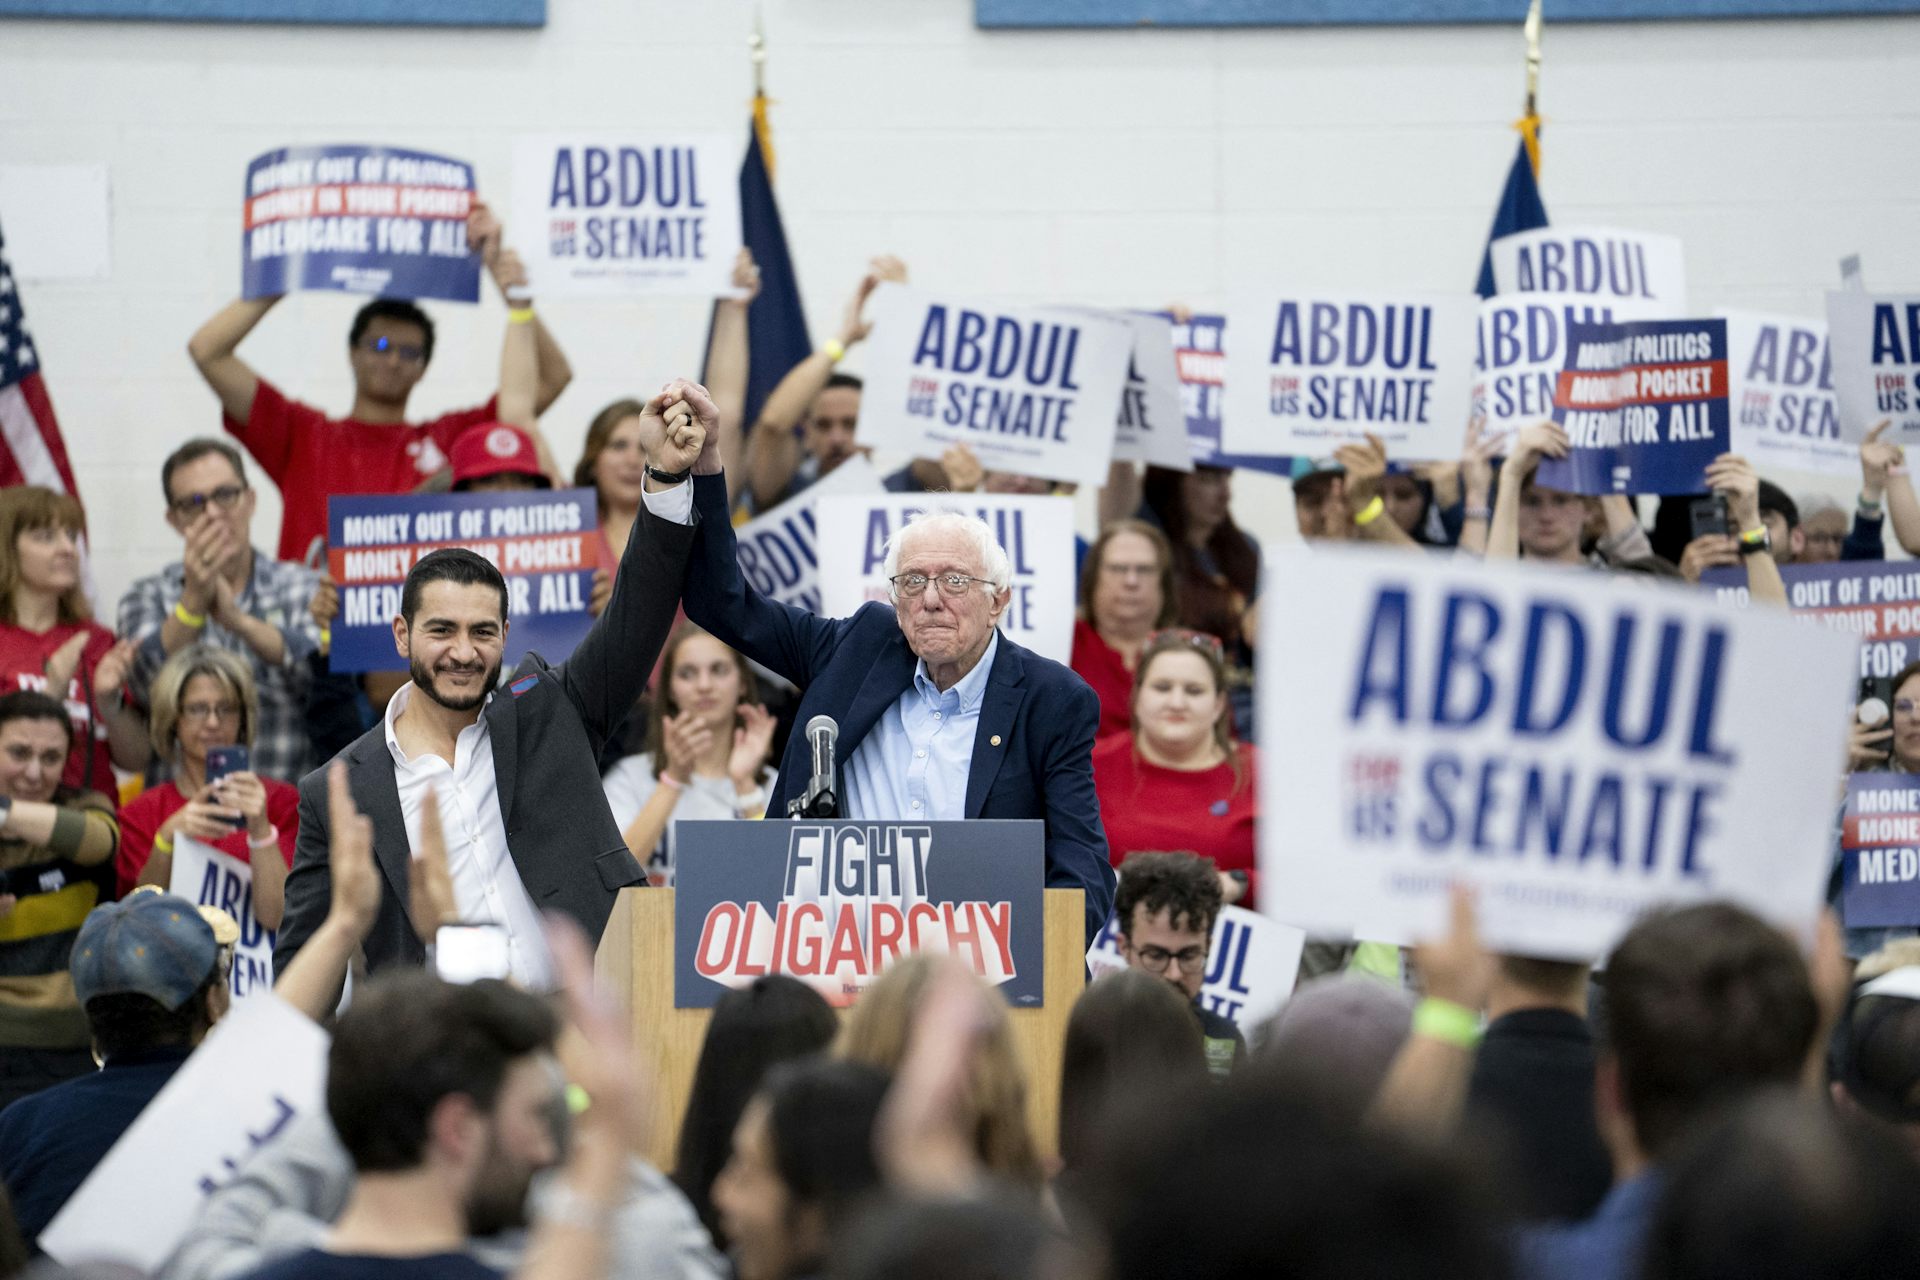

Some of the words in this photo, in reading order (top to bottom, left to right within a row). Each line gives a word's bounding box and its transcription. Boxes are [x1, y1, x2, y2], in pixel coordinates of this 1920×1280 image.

[550, 147, 706, 209] ABDUL
[585, 217, 706, 260] SENATE
[1519, 238, 1657, 299] ABDUL
[912, 304, 1080, 391] ABDUL
[1271, 301, 1437, 371] ABDUL
[1308, 375, 1433, 423] SENATE
[1641, 366, 1713, 398] POCKET
[943, 381, 1075, 443] SENATE
[1624, 405, 1659, 445] FOR
[1669, 402, 1715, 442] ALL
[344, 513, 410, 546] MONEY
[415, 511, 453, 542] OUT
[459, 509, 484, 539] OF
[490, 502, 581, 537] POLITICS
[344, 548, 411, 581] MONEY
[505, 536, 582, 571] POCKET
[539, 573, 585, 614] ALL
[1793, 580, 1832, 607] OUT
[1838, 577, 1862, 605] OF
[1349, 583, 1737, 767] ABDUL
[1861, 642, 1907, 678] FOR
[1418, 752, 1722, 884] SENATE
[784, 826, 932, 898] FIGHT
[695, 901, 1017, 977] OLIGARCHY
